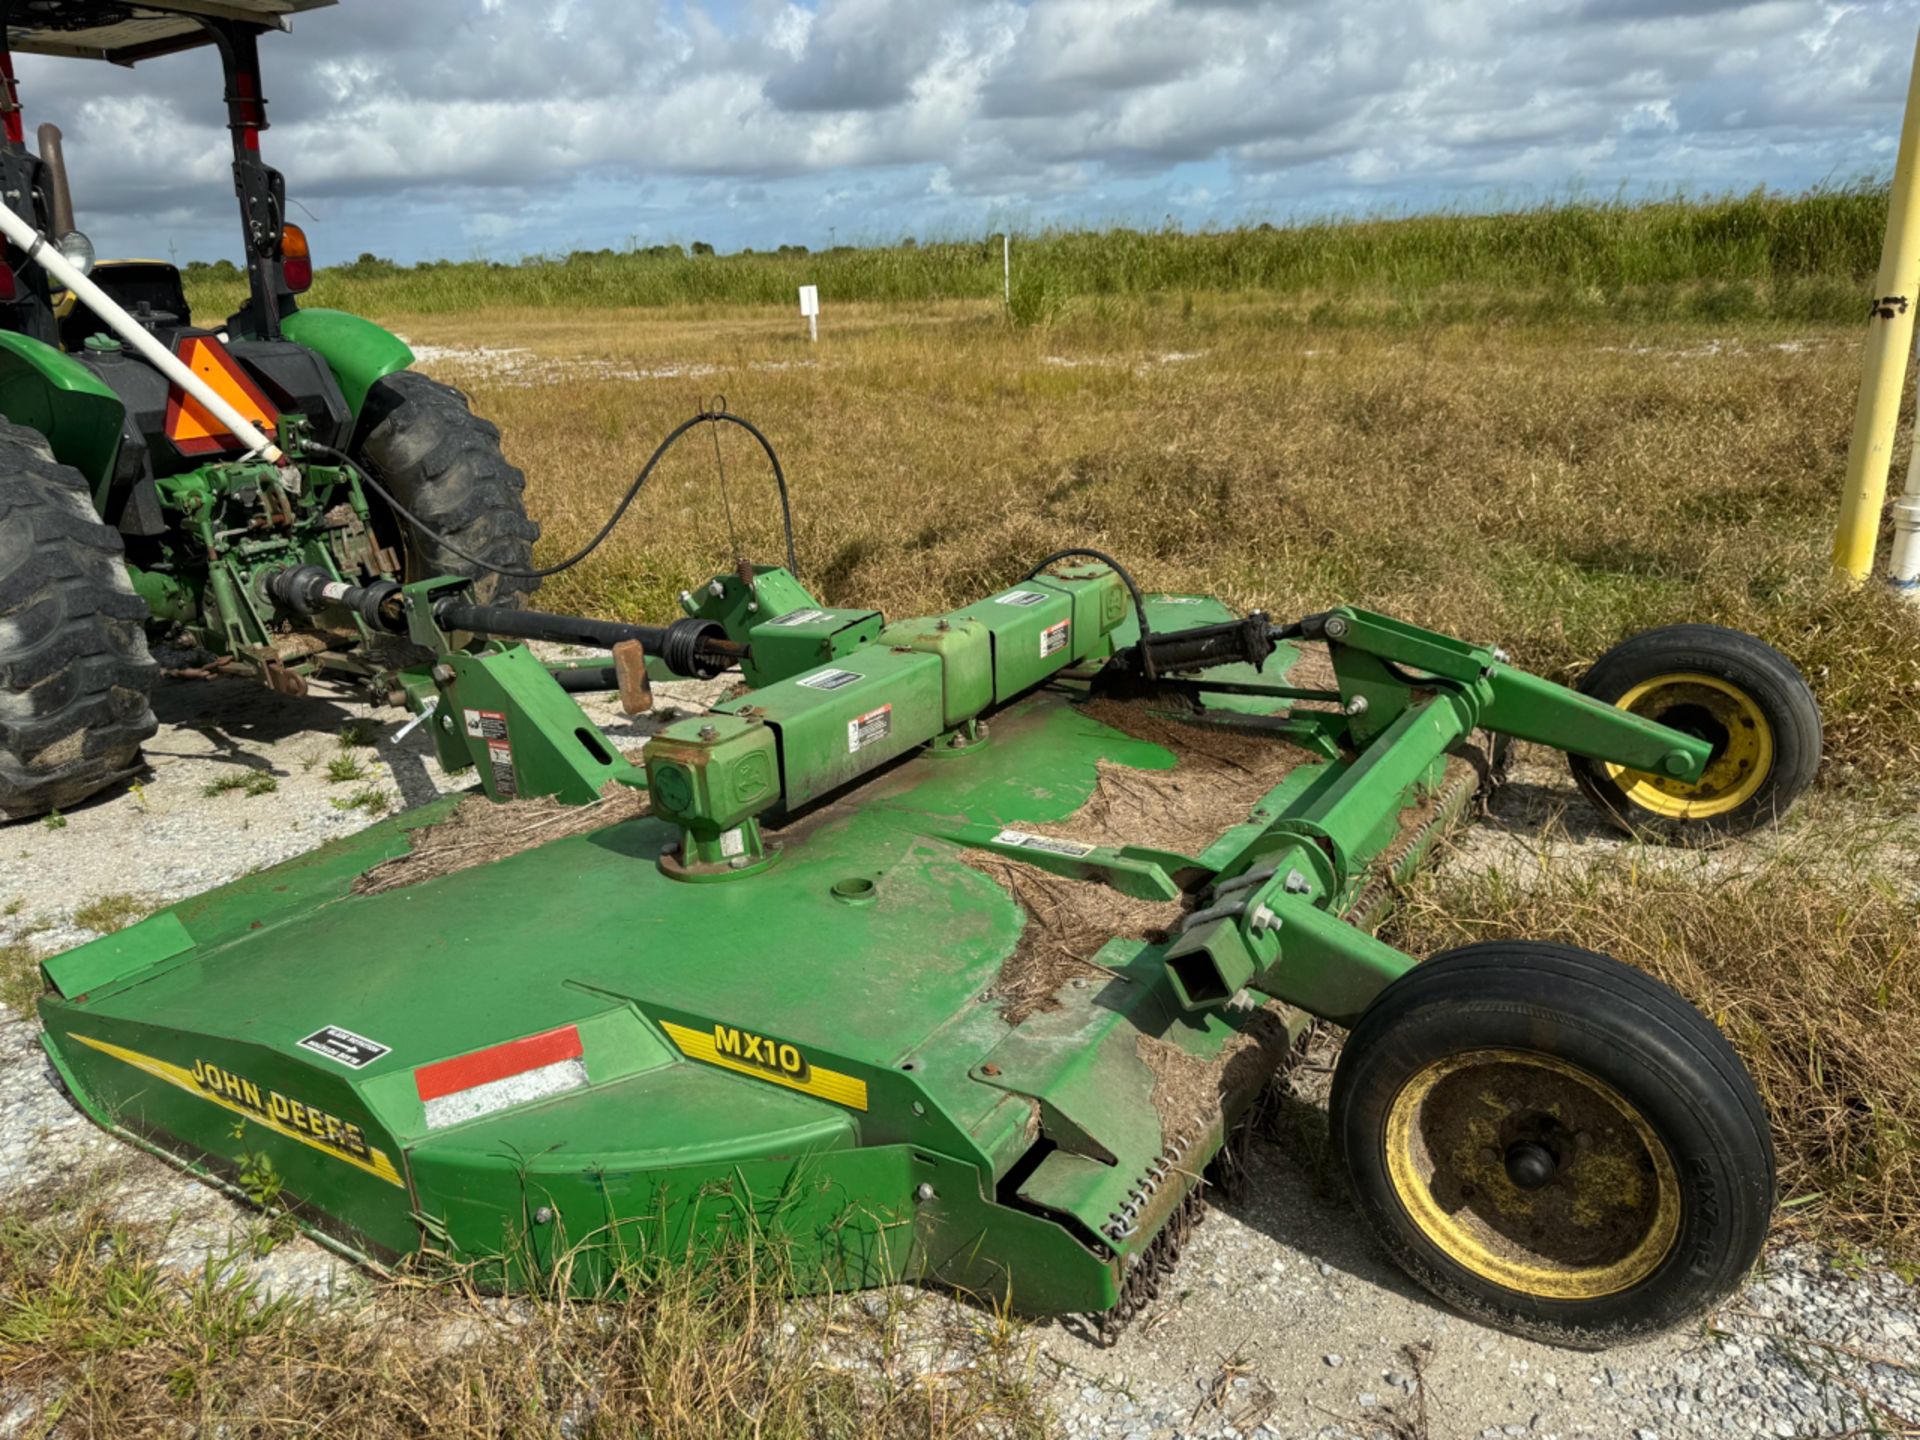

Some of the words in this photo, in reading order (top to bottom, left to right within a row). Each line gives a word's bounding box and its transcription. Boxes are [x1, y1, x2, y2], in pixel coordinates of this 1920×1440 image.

[714, 1024, 802, 1074] MX10
[191, 1058, 262, 1109] JOHN
[270, 1090, 366, 1154] DEERE
